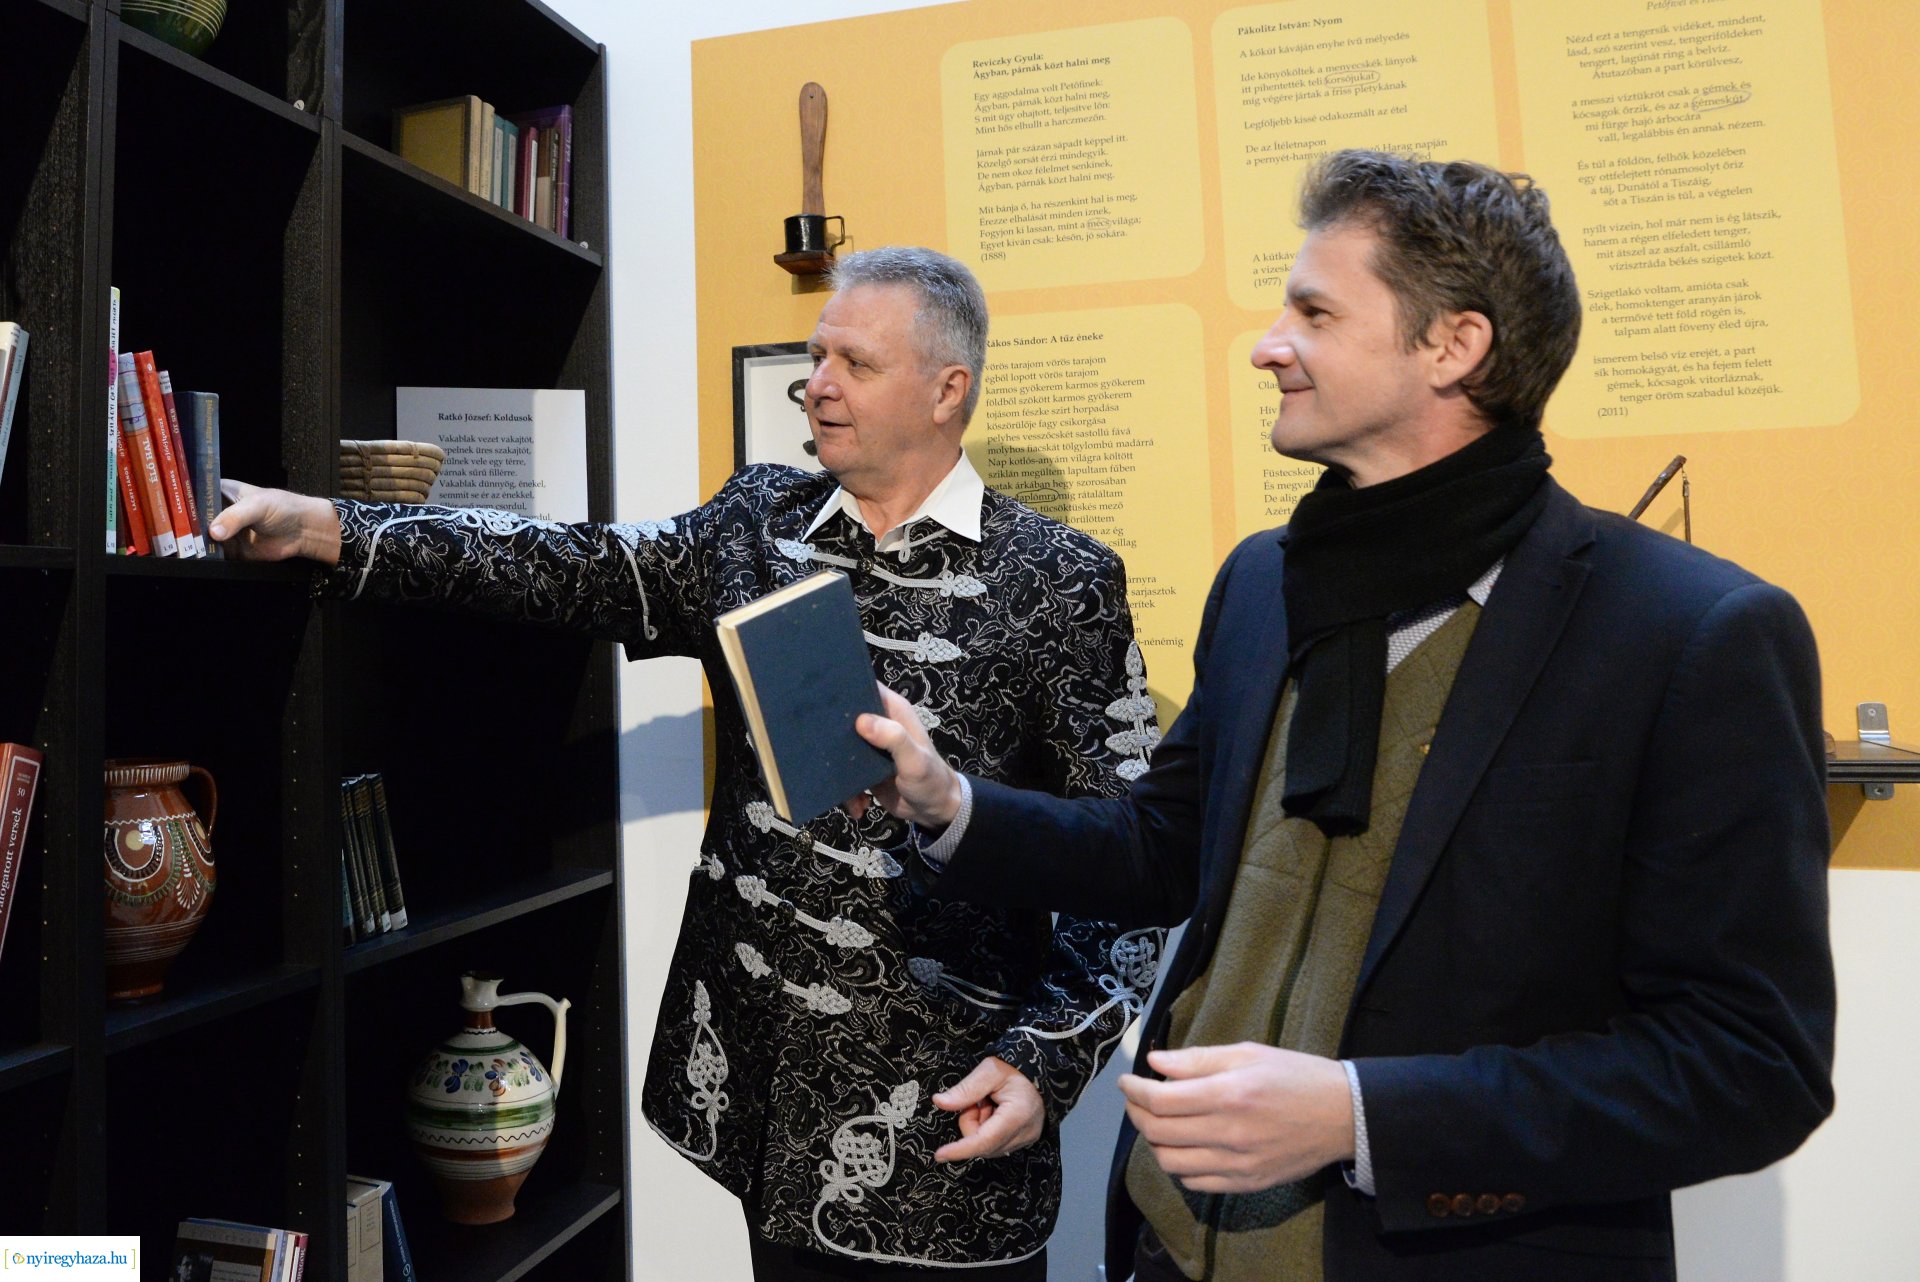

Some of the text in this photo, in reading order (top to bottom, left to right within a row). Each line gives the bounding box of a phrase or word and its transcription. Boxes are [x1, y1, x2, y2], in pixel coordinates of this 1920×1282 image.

[1238, 18, 1342, 35] Pákolitz István: Nyom
[973, 52, 1044, 68] Reviczky Gyula:
[1241, 71, 1256, 81] Ide
[1258, 65, 1315, 80] könyököltek
[1326, 58, 1383, 73] menyecskék
[1385, 54, 1417, 67] lányok
[974, 57, 1110, 80] Ágyban, párnák közt halni meg
[975, 91, 1110, 113] Ágyban, párnák közt halni meg,
[1244, 115, 1292, 130] Legföljebb
[1294, 114, 1317, 124] kissé
[1319, 108, 1375, 121] odakozmált
[1391, 104, 1407, 115] étel
[1246, 144, 1259, 153] De
[1274, 139, 1328, 150] Ítéletnapon
[1382, 138, 1448, 152] Harag napján
[981, 250, 1006, 262] (1888)
[1254, 275, 1283, 288] (1977)
[1588, 279, 1750, 300] Szigetlakó voltam, amióta csak
[1588, 291, 1762, 312] élek, homoktenger aranyán járok
[1014, 335, 1048, 346] Sándor:
[1050, 335, 1058, 343] A
[1060, 334, 1074, 343] tűz
[1077, 331, 1103, 342] éneke
[986, 355, 1107, 371] vörös tarajom vörös tarajom
[986, 377, 1146, 395] karmos gyökerem karmos gyökerem
[1607, 372, 1763, 391] gémek, kócsagok vitorláznak,
[1620, 385, 1783, 403] tenger öröm szabadul közéjük.
[438, 412, 534, 423] Ratkó József: Koldusok
[986, 403, 1119, 420] tojásom fészke szirt horpadása
[1597, 407, 1630, 419] (2011)
[439, 434, 476, 443] Vakablak
[501, 434, 535, 445] vakajtót,
[142, 436, 154, 461] HAL
[471, 456, 526, 468] vele egy térre,
[988, 451, 1134, 468] Nap kotlós-anyám világra költött
[440, 468, 517, 476] várnak sűrű fillérre.
[1263, 466, 1316, 477] Füstecskéd
[440, 479, 546, 490] Vakablak dünnyög, énekel,
[439, 491, 469, 499] semmit
[481, 491, 489, 499] ér
[502, 490, 535, 500] énekkel,
[1264, 493, 1299, 504] De alig
[1108, 537, 1137, 549] csillag
[1131, 586, 1176, 598] sarjasztok
[0, 808, 22, 914] logatott versek
